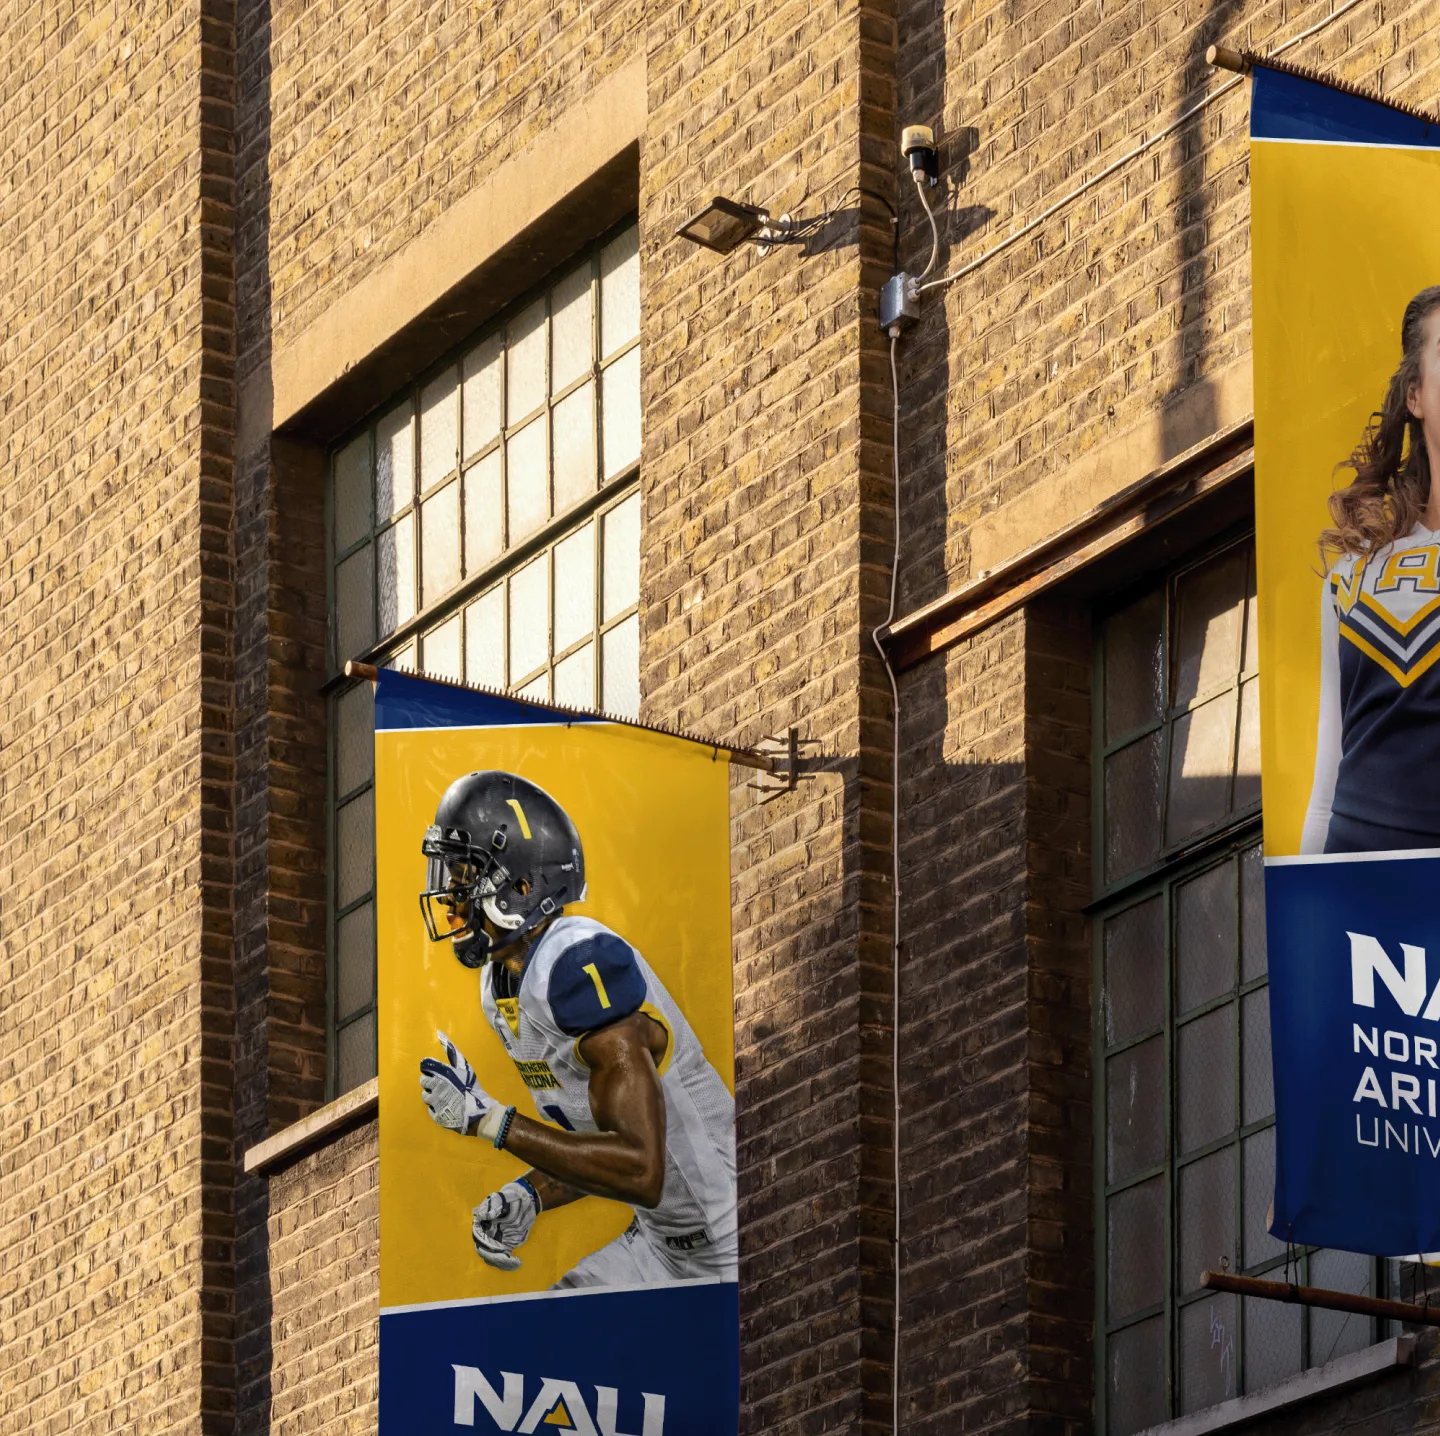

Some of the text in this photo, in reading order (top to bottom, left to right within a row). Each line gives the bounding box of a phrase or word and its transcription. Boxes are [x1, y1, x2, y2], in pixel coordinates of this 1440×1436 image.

[506, 799, 532, 840] 1
[582, 963, 611, 1009] 1
[514, 1061, 551, 1073] THERN
[451, 1363, 665, 1436] NAU
